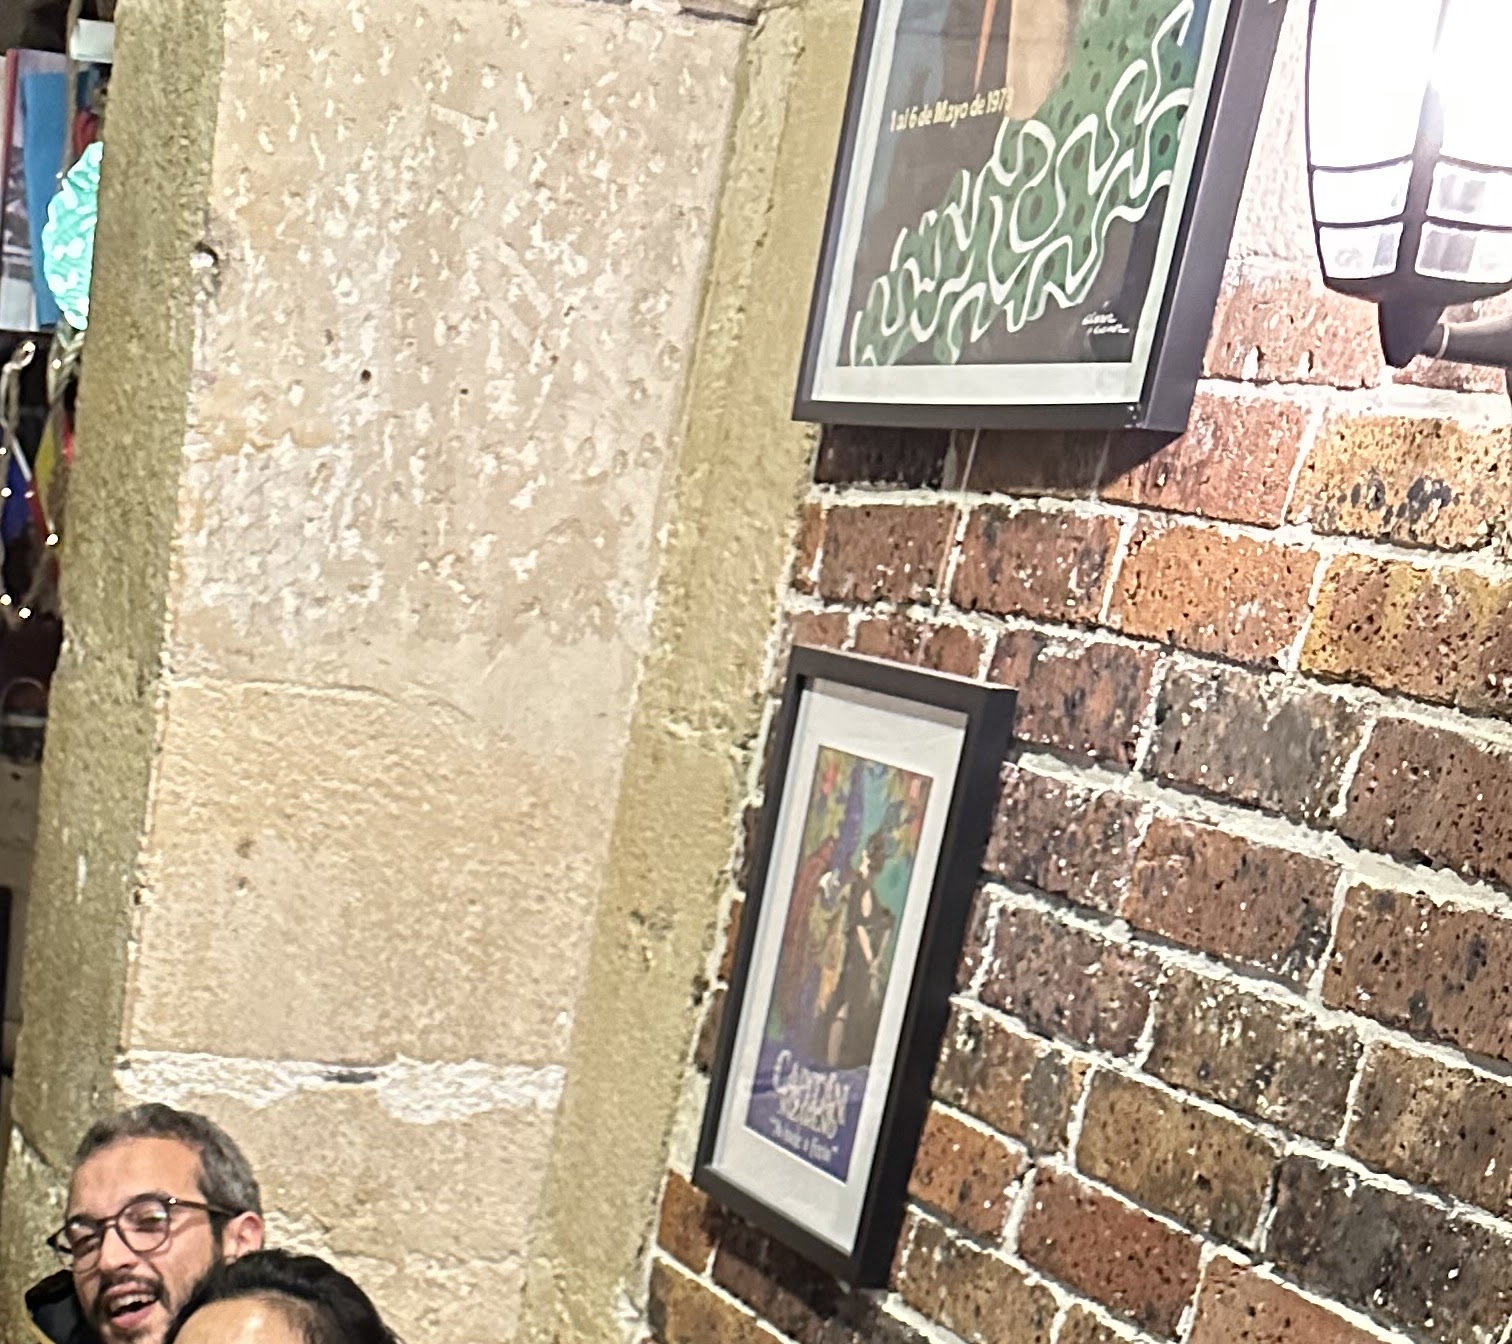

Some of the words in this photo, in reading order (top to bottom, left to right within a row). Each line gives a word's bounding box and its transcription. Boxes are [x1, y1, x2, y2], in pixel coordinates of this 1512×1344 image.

[917, 103, 934, 127] de
[933, 98, 970, 129] Mayo
[969, 92, 987, 117] de
